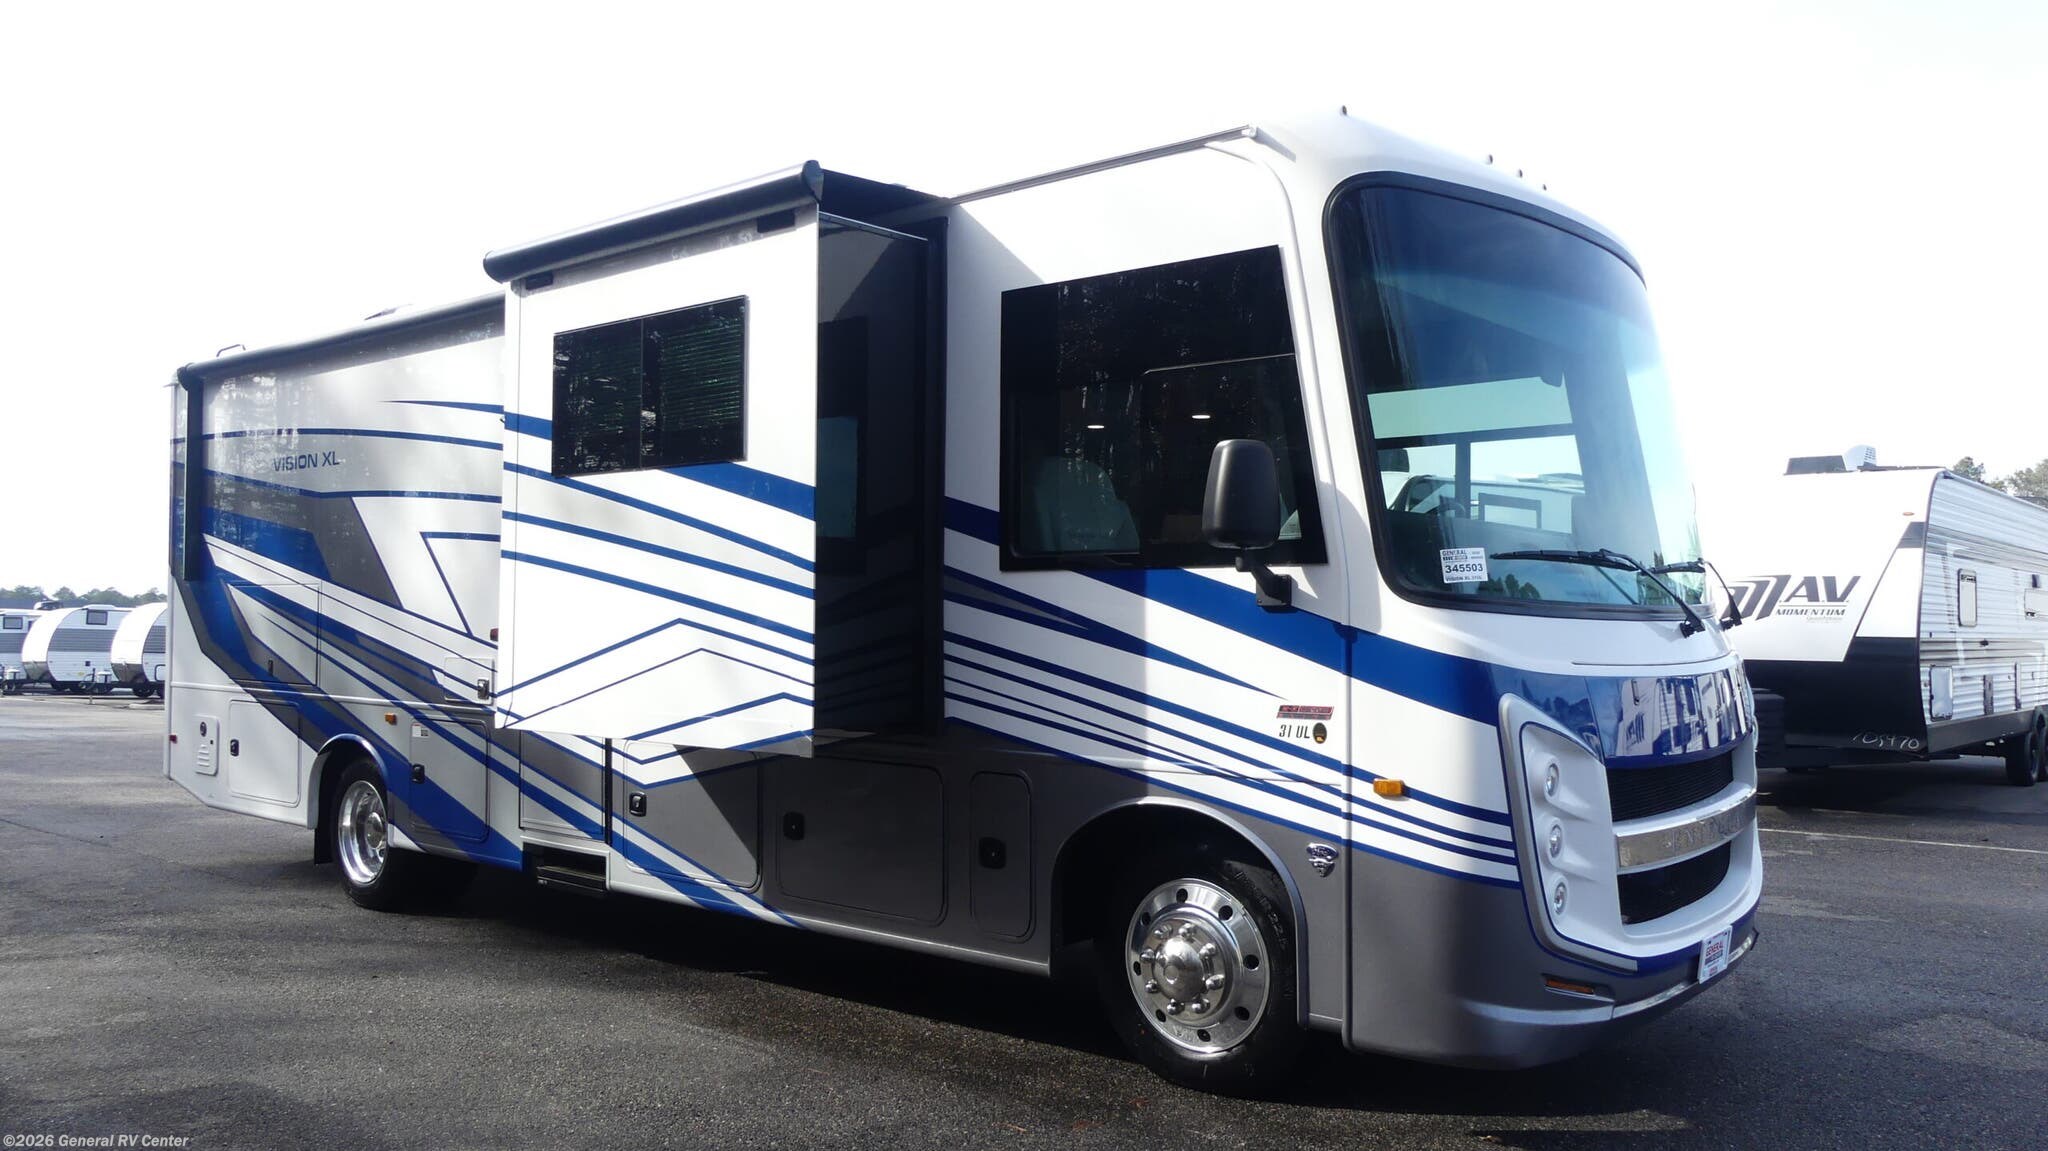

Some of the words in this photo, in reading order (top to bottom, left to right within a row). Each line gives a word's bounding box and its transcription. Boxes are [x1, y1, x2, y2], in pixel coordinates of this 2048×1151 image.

[273, 453, 318, 472] VISION
[322, 451, 340, 467] XL
[1445, 563, 1483, 574] 345503
[1776, 608, 1846, 616] MOMENTUM
[1279, 724, 1292, 738] 31
[1296, 725, 1310, 739] UL
